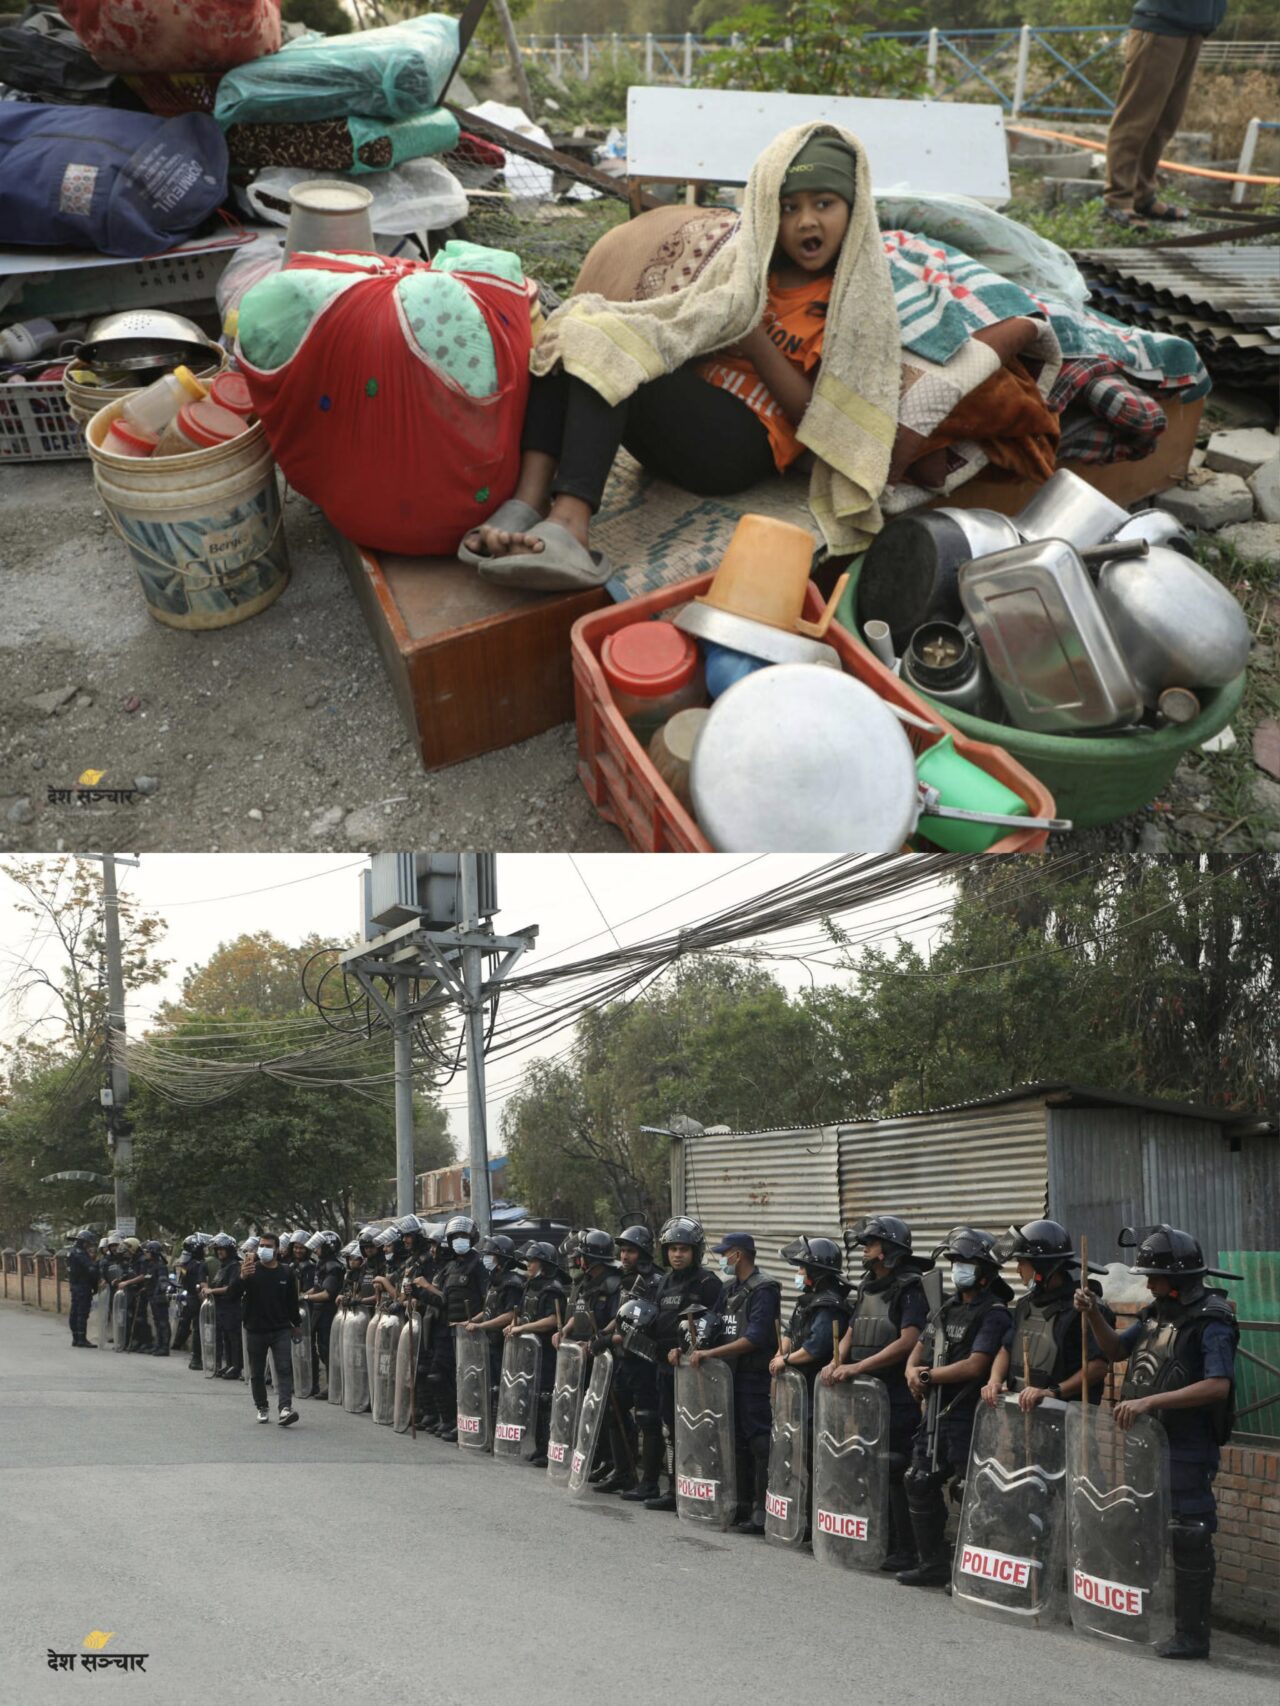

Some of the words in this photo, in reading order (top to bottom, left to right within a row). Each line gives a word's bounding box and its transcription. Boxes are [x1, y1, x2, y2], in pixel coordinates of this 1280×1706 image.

[152, 159, 203, 212] DORMEUIL
[678, 1479, 714, 1499] POLICE
[818, 1511, 866, 1538] POLICE
[961, 1550, 1027, 1585] POLICE
[1074, 1573, 1139, 1614] POLICE
